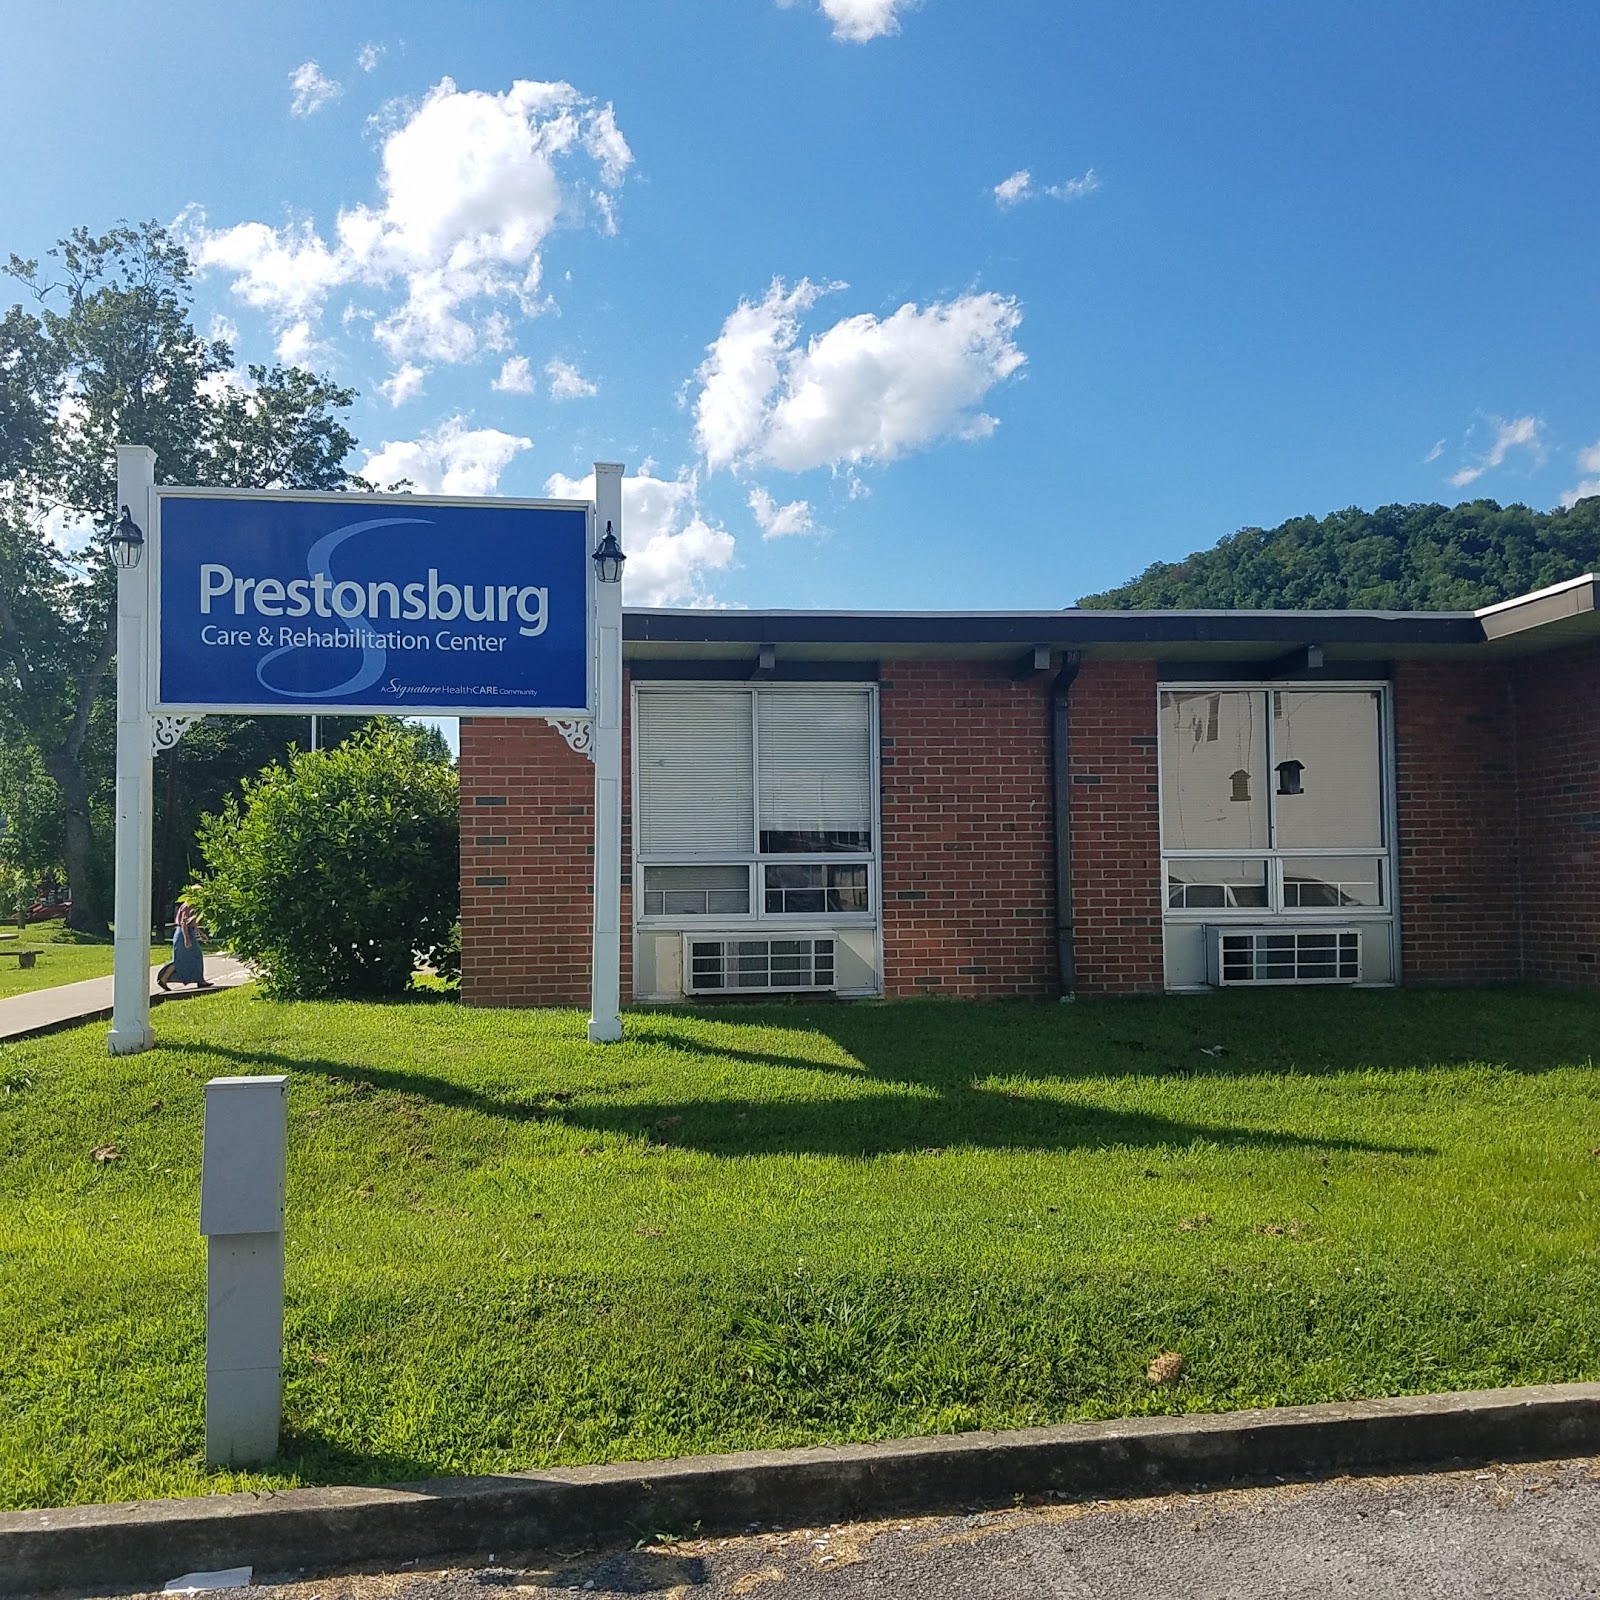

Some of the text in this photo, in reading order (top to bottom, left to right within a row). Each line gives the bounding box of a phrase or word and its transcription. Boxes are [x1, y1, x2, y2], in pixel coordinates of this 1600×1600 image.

[200, 563, 549, 637] Prestonsburg
[201, 625, 507, 653] Care & Rehabilitation Center
[387, 678, 441, 698] Signature
[441, 686, 499, 695] HealthCARE
[499, 688, 538, 697] Community
